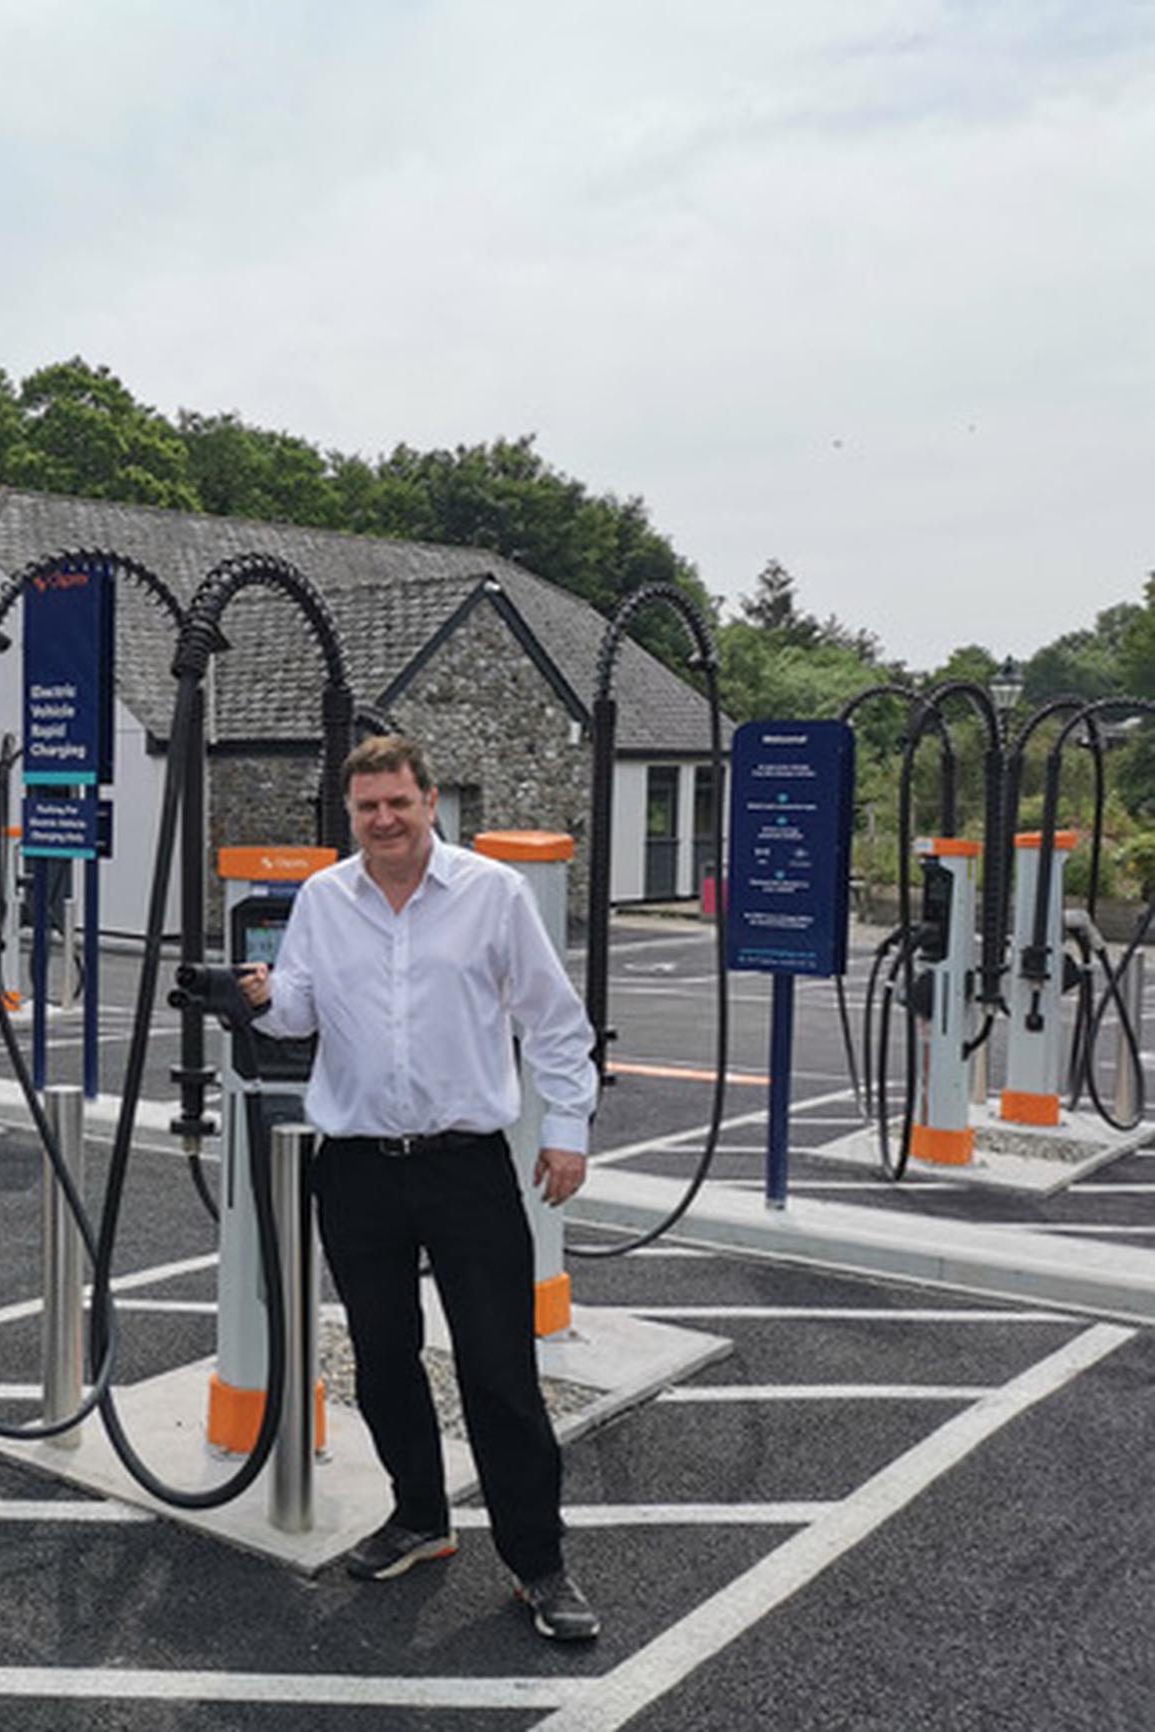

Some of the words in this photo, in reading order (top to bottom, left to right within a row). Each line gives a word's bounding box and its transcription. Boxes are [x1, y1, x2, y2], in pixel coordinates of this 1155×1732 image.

[30, 683, 76, 699] Electric
[30, 703, 75, 718] Vehicle
[30, 722, 66, 740] Rapid
[30, 742, 86, 760] Charging
